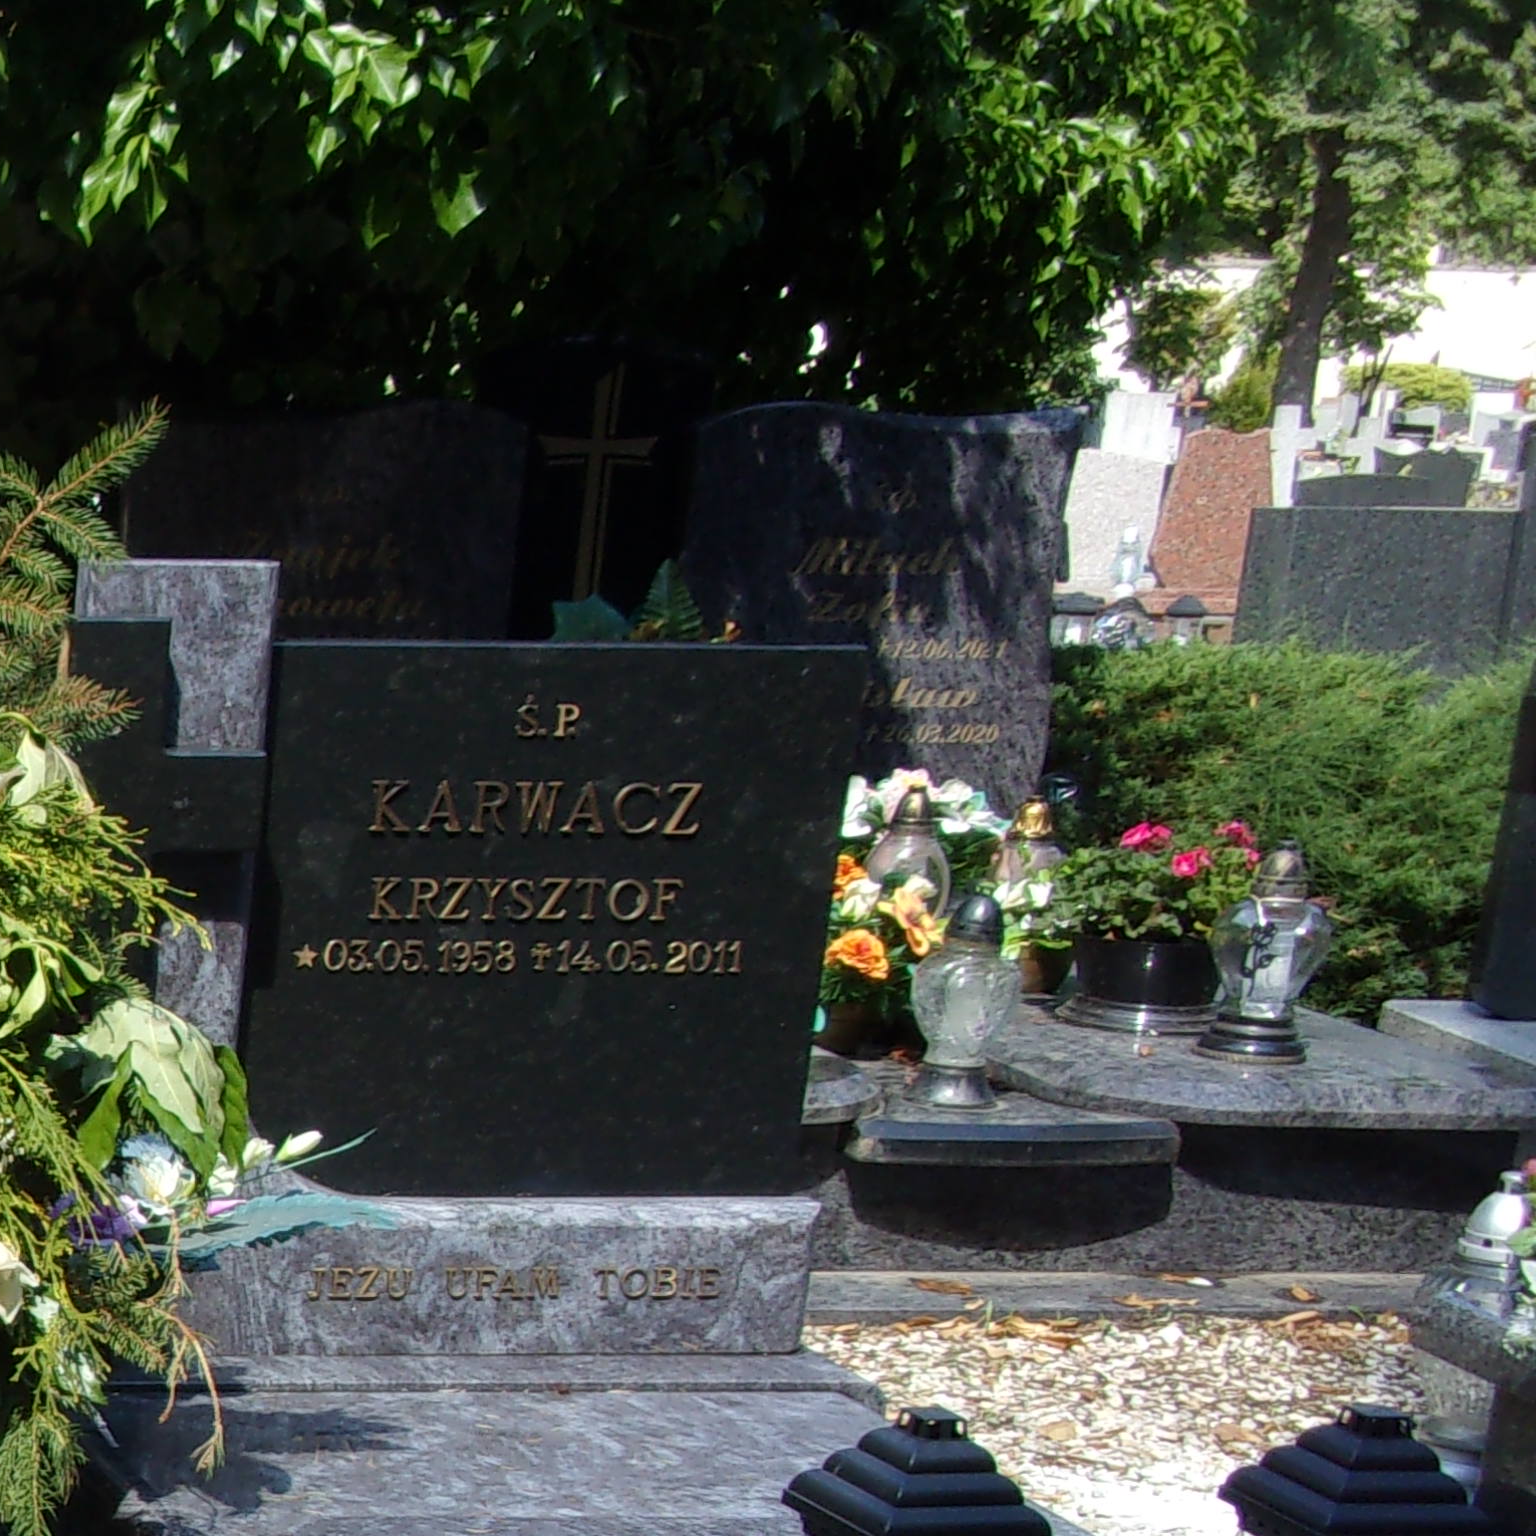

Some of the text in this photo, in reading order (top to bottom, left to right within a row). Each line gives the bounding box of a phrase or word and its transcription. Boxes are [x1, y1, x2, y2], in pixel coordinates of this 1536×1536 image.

[367, 778, 705, 837] KARWACZ
[367, 876, 685, 922] KRZYSZTOF
[323, 937, 743, 974] 03.05.1958 14.05.2011
[306, 1264, 723, 1301] JEZU UFAM TOBIE
